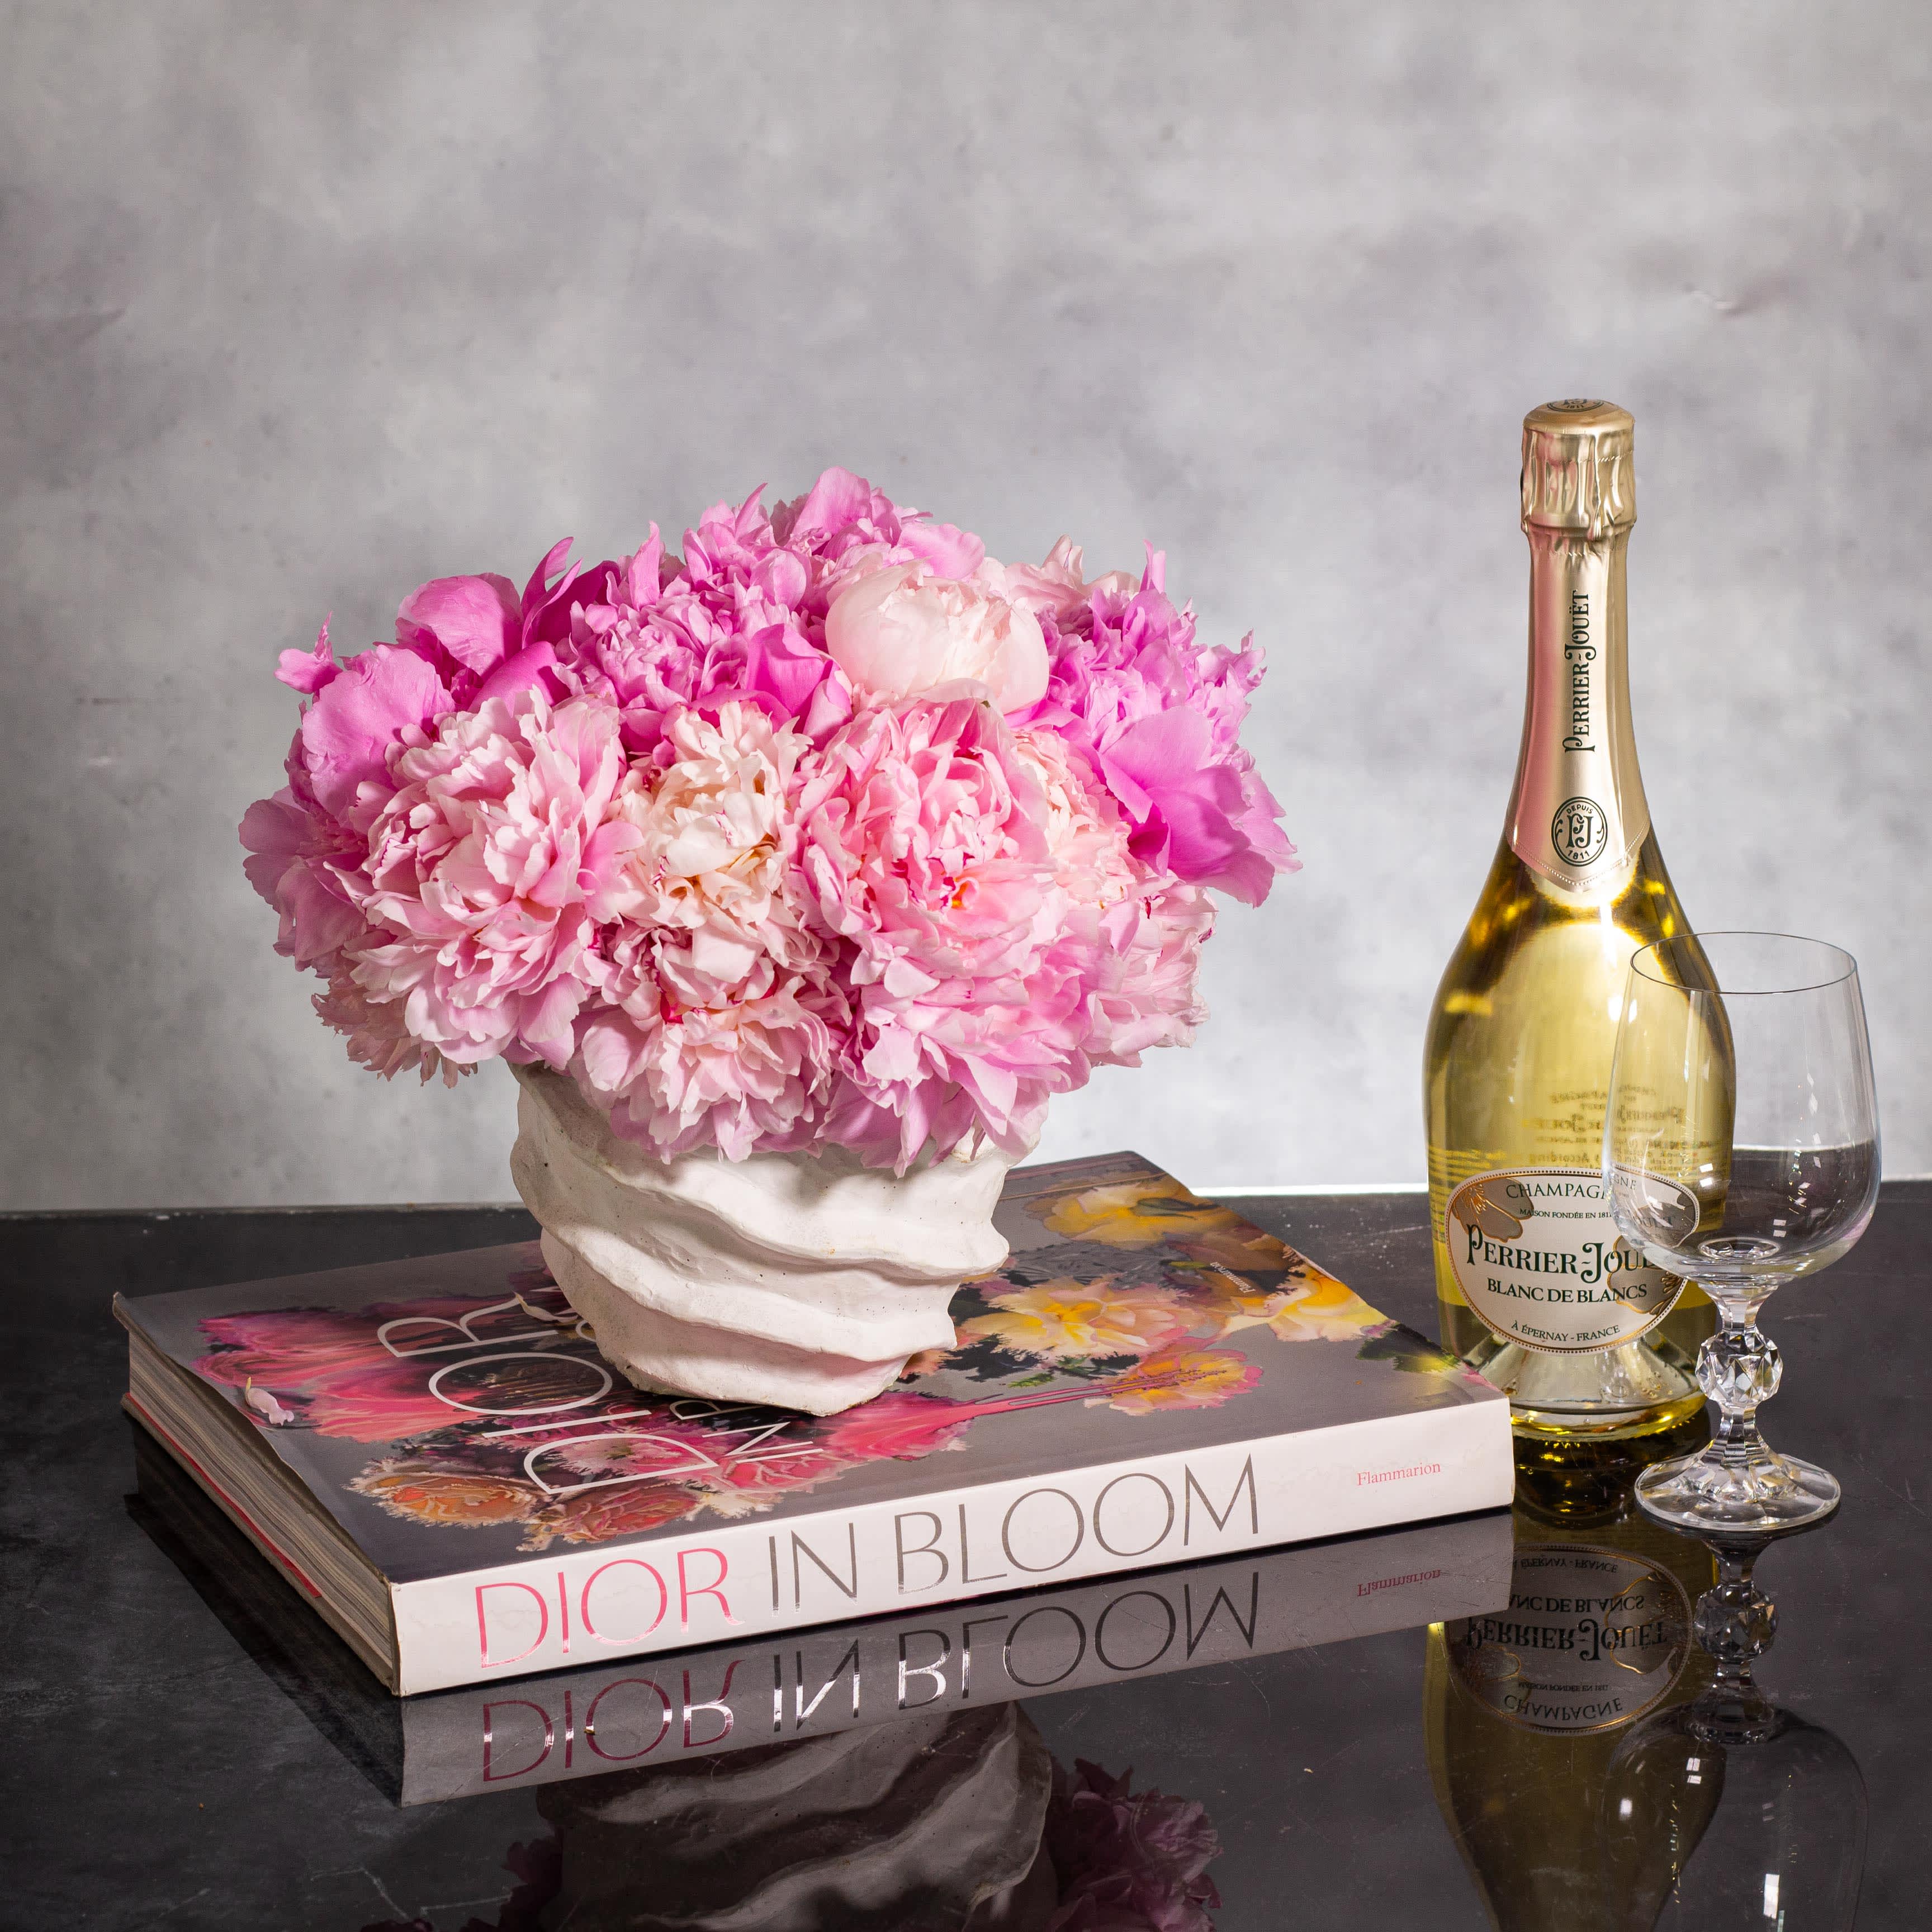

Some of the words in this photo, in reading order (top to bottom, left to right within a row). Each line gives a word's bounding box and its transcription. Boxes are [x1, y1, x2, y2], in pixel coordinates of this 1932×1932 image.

[1566, 804, 1593, 814] DEPUIS
[1568, 850, 1589, 859] 1811
[1519, 1209, 1550, 1218] MAISON
[1467, 1224, 1656, 1284] PERRIER-JOU
[1209, 1261, 1254, 1293] Flammarion
[1488, 1278, 1544, 1301] BLANC
[1548, 1289, 1574, 1302] DE
[1577, 1284, 1647, 1303] BLANCS
[1512, 1321, 1519, 1331] À
[1521, 1324, 1569, 1342] ÉPERNAY
[1577, 1325, 1620, 1341] FRANCE
[377, 1298, 719, 1495] DIOR
[1357, 1462, 1441, 1486] Flammarion
[475, 1549, 745, 1669] DIOR
[769, 1523, 858, 1617] IN
[894, 1453, 1258, 1594] BLOOM
